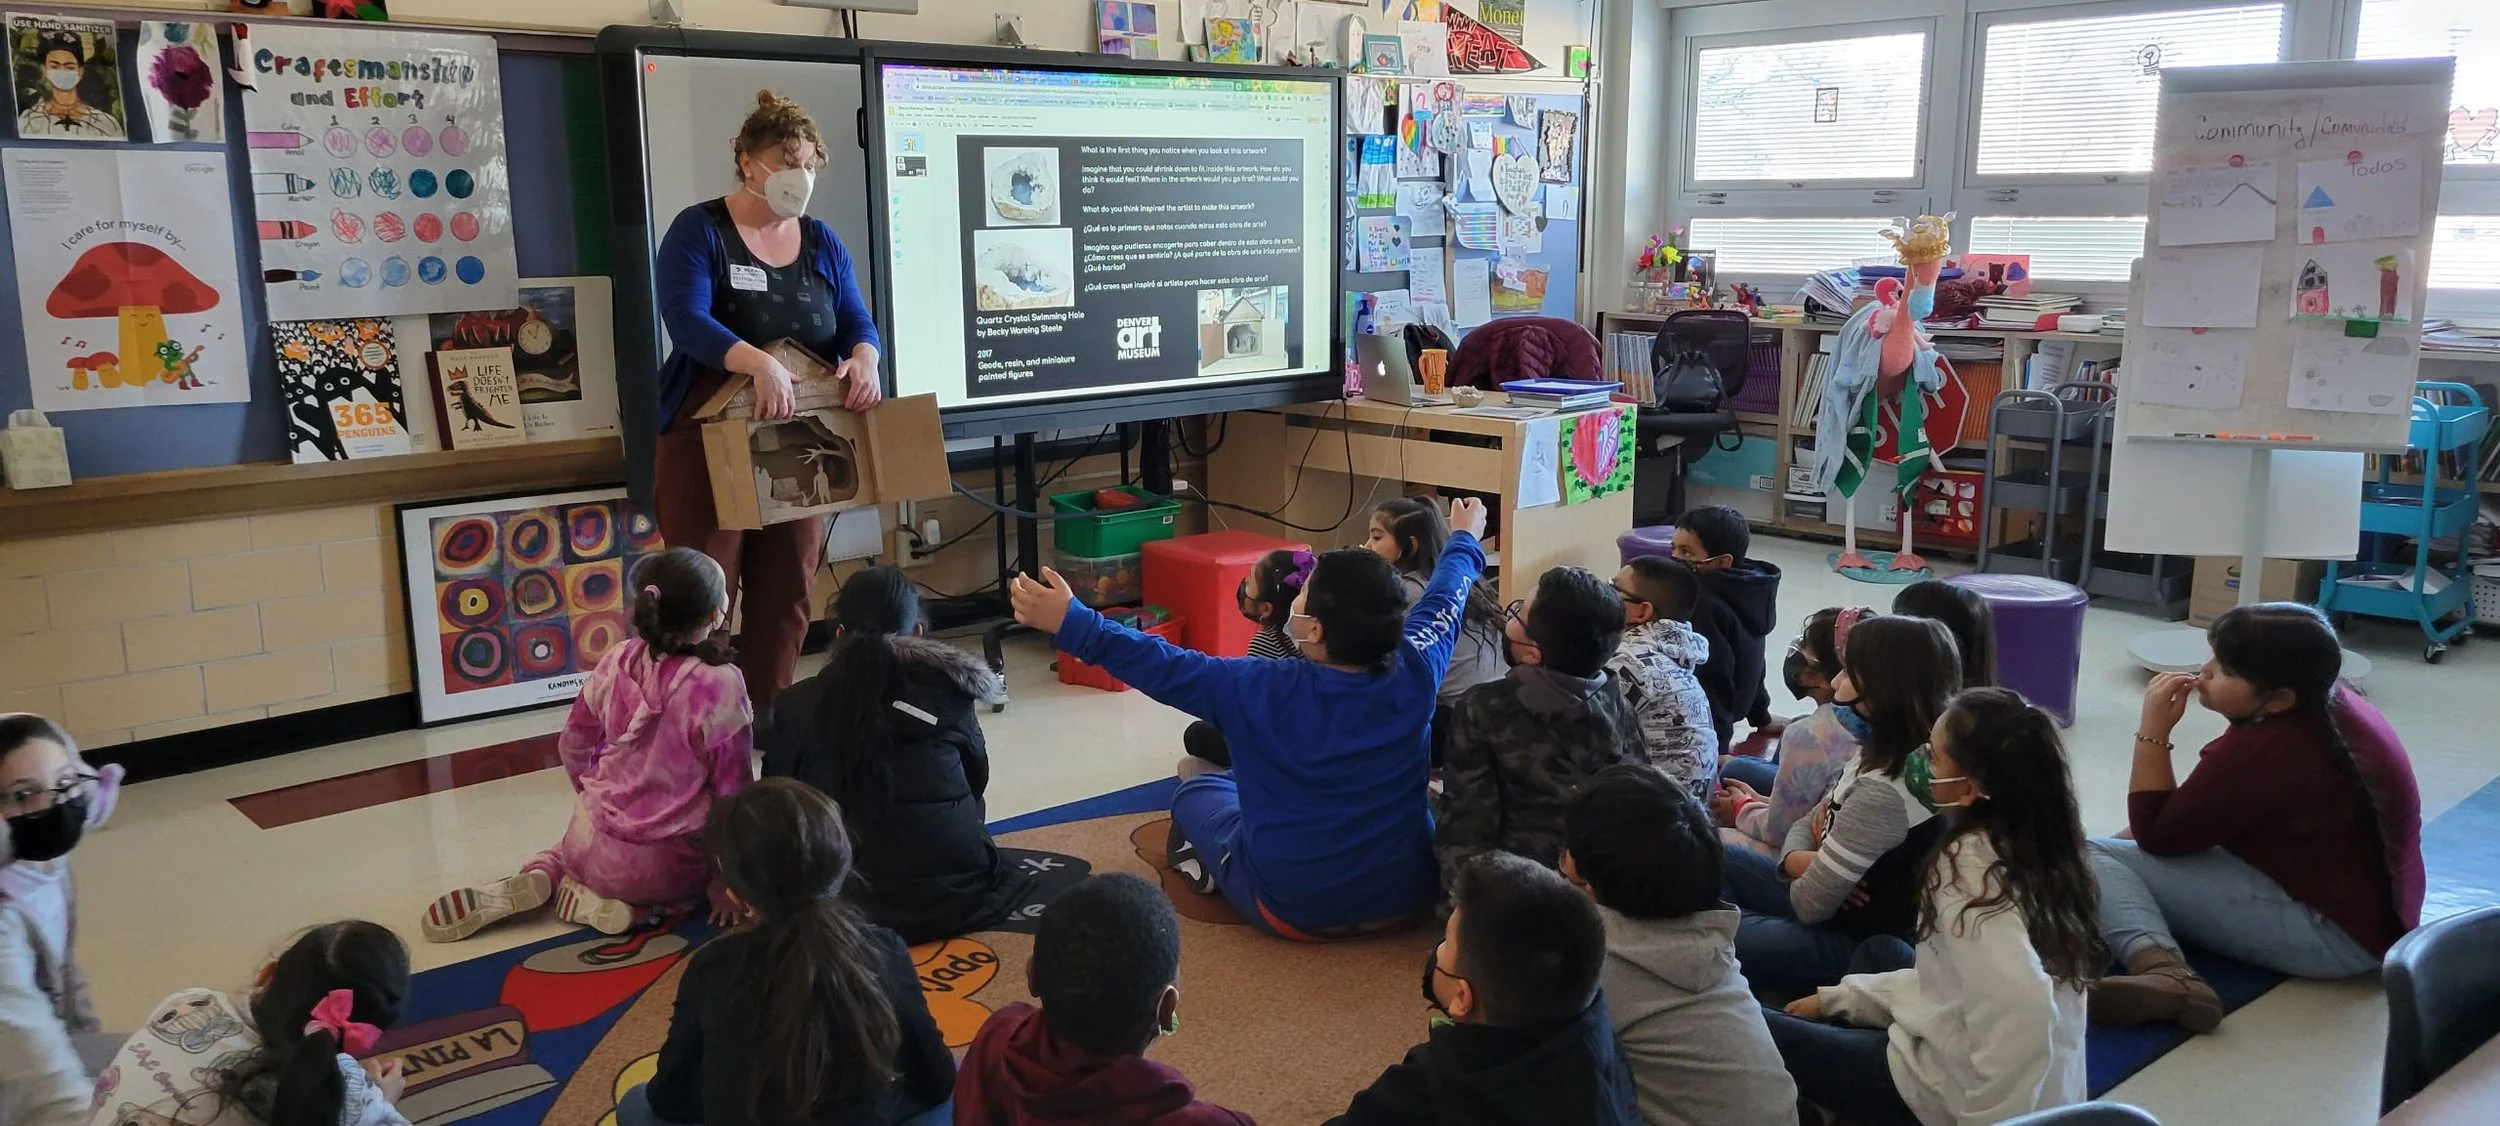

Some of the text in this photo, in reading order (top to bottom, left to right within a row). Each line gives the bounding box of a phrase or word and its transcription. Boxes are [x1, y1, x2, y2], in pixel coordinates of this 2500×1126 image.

[13, 19, 112, 34] USE HAND SANITIZER
[254, 48, 474, 88] Craftsmanship
[291, 87, 425, 109] and Effort
[330, 114, 455, 126] 1 2 3 4
[1081, 146, 1098, 154] What
[1106, 146, 1117, 154] the
[1118, 146, 1130, 154] first
[1132, 147, 1148, 155] thing
[1082, 166, 1107, 174] Imagine
[1123, 166, 1134, 174] you
[1082, 186, 1095, 194] do?
[1140, 204, 1165, 213] inspired
[69, 225, 95, 245] care
[96, 220, 116, 231] for
[119, 220, 165, 236] myself
[1083, 225, 1100, 234] ¿Qué
[1118, 224, 1142, 233] primero
[1252, 220, 1267, 228] arte?
[295, 241, 320, 250] Crayon
[1084, 244, 1110, 252] Imagina
[1124, 242, 1151, 251] pudieras
[1153, 242, 1183, 250] encogerte
[1084, 263, 1126, 273] ¿Qué harías?
[1084, 283, 1101, 292] ¿Qué
[1121, 283, 1133, 292] que
[1134, 280, 1155, 289] inspiró
[1184, 279, 1198, 287] para
[976, 311, 1085, 324] Quartz Crystal Swimming Hole
[1117, 318, 1152, 328] DENVER
[977, 324, 1062, 338] by Becky Wareing Steele
[1116, 317, 1161, 349] art
[977, 350, 992, 358] 2017
[1118, 348, 1160, 360] MUSEUM
[978, 356, 1075, 370] Geode, resin, and miniature
[477, 365, 502, 377] LIFE
[978, 370, 1034, 383] painted figures
[488, 393, 510, 406] ME
[334, 402, 393, 428] 365
[337, 427, 396, 439] PENGUINS
[548, 677, 590, 690] KANDINSK
[468, 1027, 518, 1051] LA
